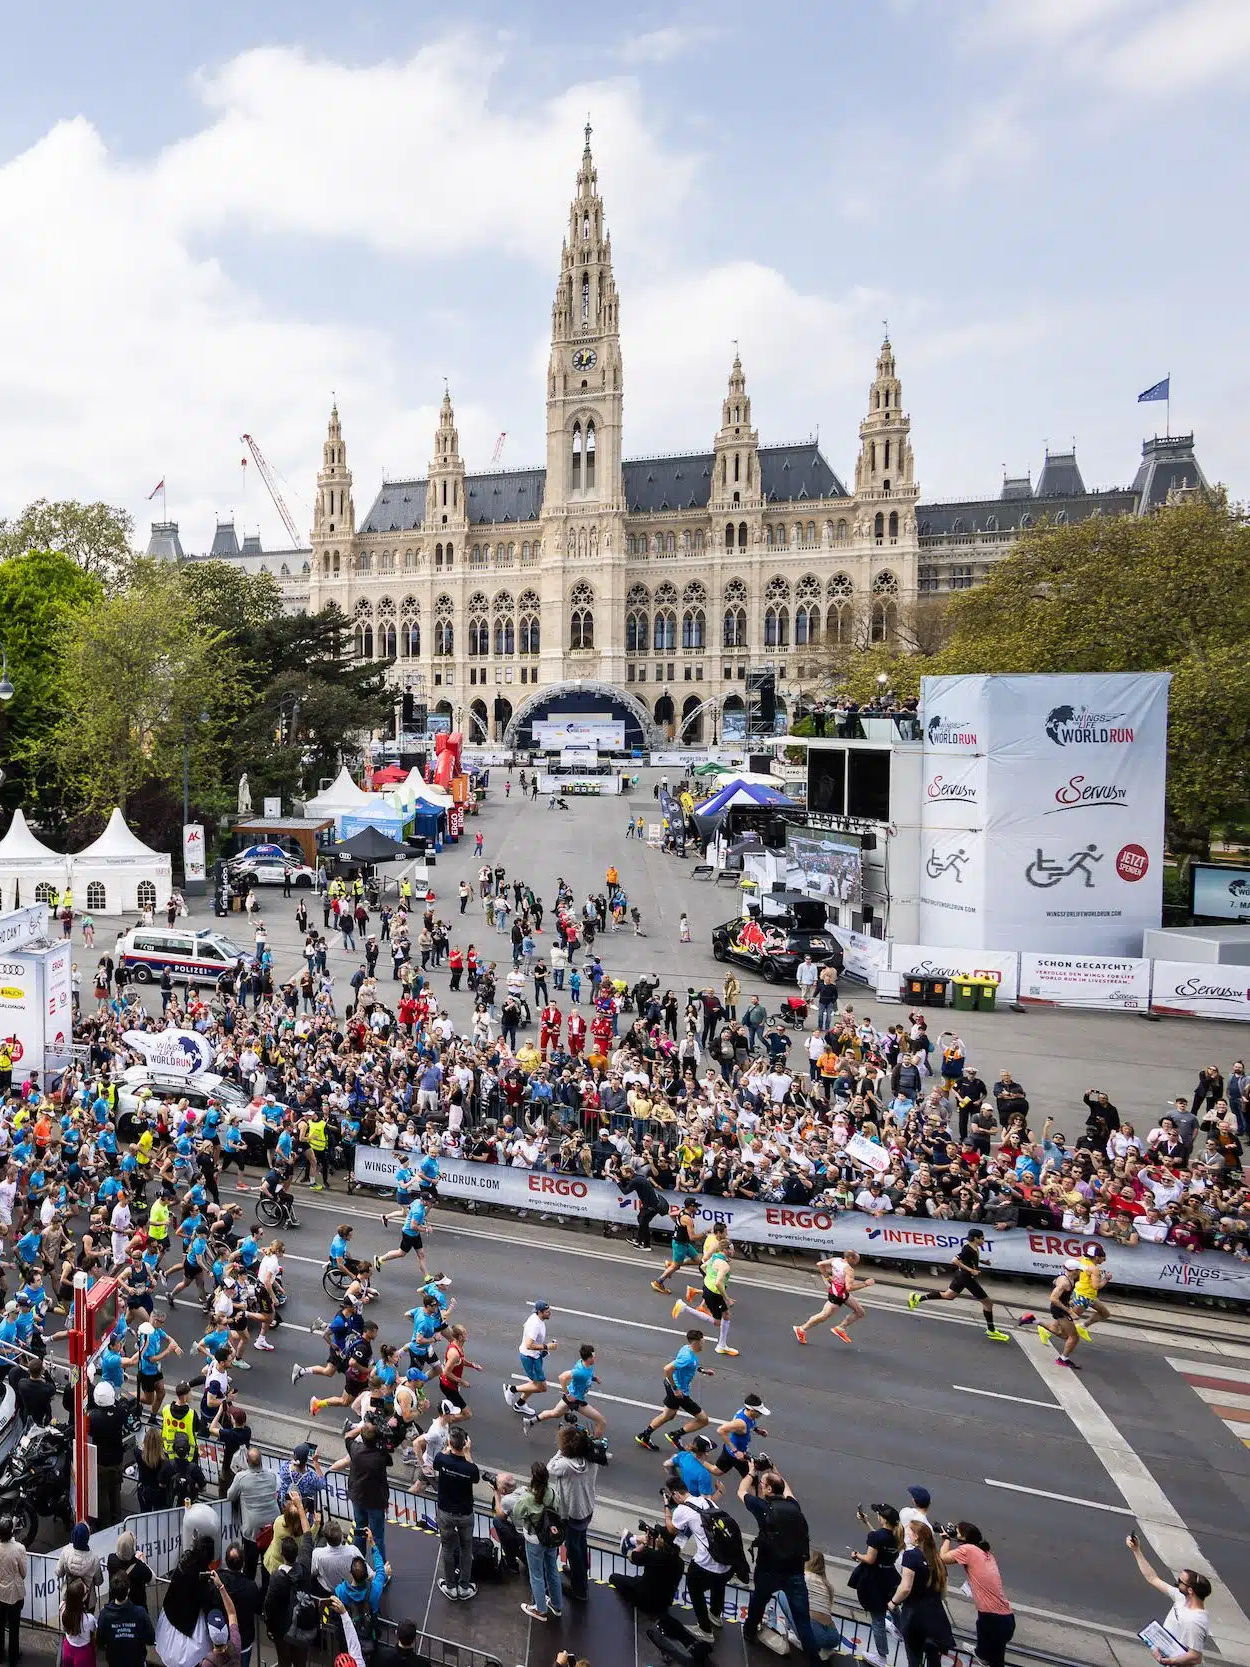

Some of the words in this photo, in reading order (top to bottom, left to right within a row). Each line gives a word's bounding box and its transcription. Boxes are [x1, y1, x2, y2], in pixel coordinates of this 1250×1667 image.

[1120, 851, 1146, 868] JETZT
[1118, 862, 1142, 876] SPENDEN
[1046, 910, 1122, 918] WINGSFORLIFEWORLDRUN.COM
[174, 964, 207, 975] POLIZEI
[1038, 959, 1072, 968] SCHON
[1075, 962, 1133, 971] GECATCHT?
[528, 1174, 588, 1198] ERGO
[528, 1198, 588, 1212] ergo-versicherung.at
[766, 1207, 833, 1231] ERGO
[767, 1232, 835, 1246] ergo-versicherung.at
[1165, 1263, 1221, 1279] WINGS
[1176, 1277, 1205, 1288] LIFE
